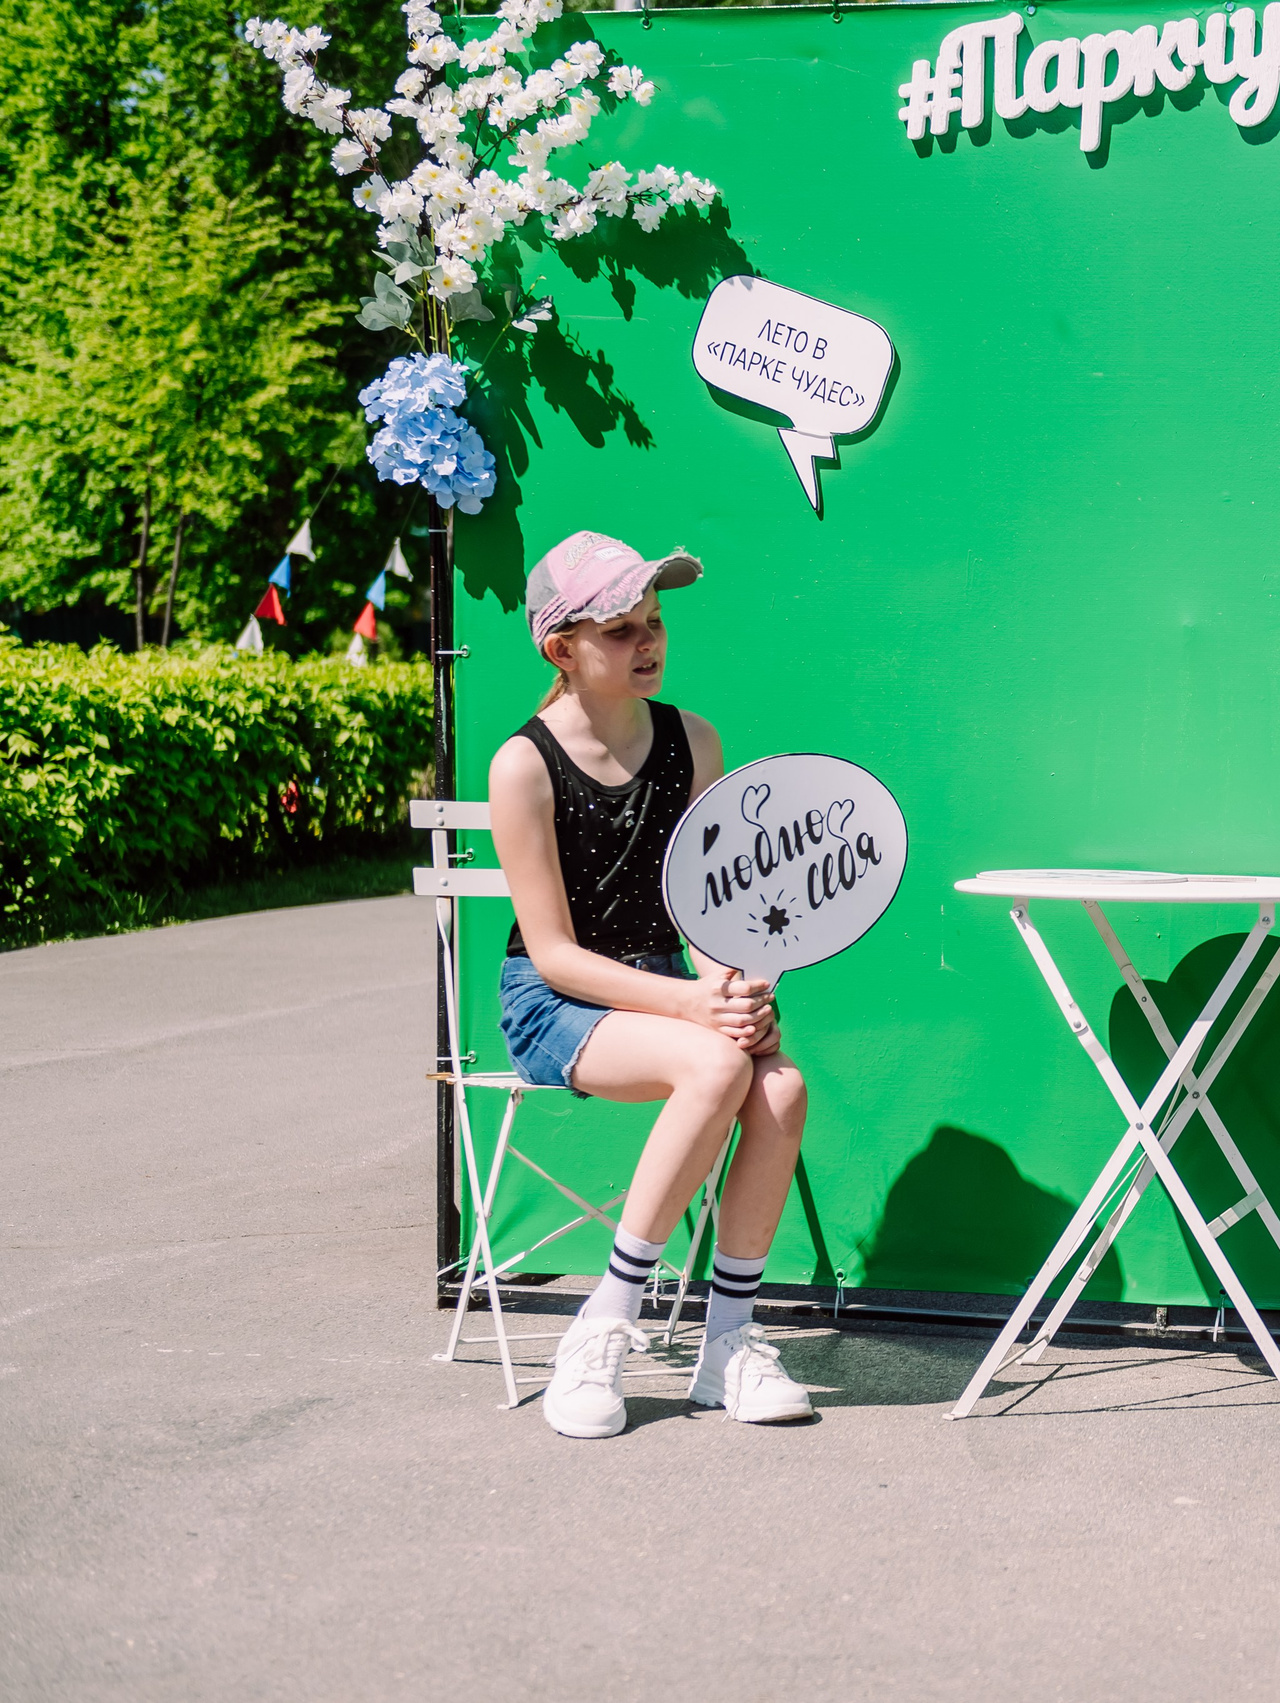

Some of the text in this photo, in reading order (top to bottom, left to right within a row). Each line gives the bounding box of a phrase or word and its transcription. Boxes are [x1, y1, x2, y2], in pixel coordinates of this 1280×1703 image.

[707, 341, 865, 407] «ПАРКЕ ЧУДЕС»
[757, 319, 828, 360] ЛЕТО В
[701, 783, 825, 915] люблю
[807, 799, 882, 910] себя
